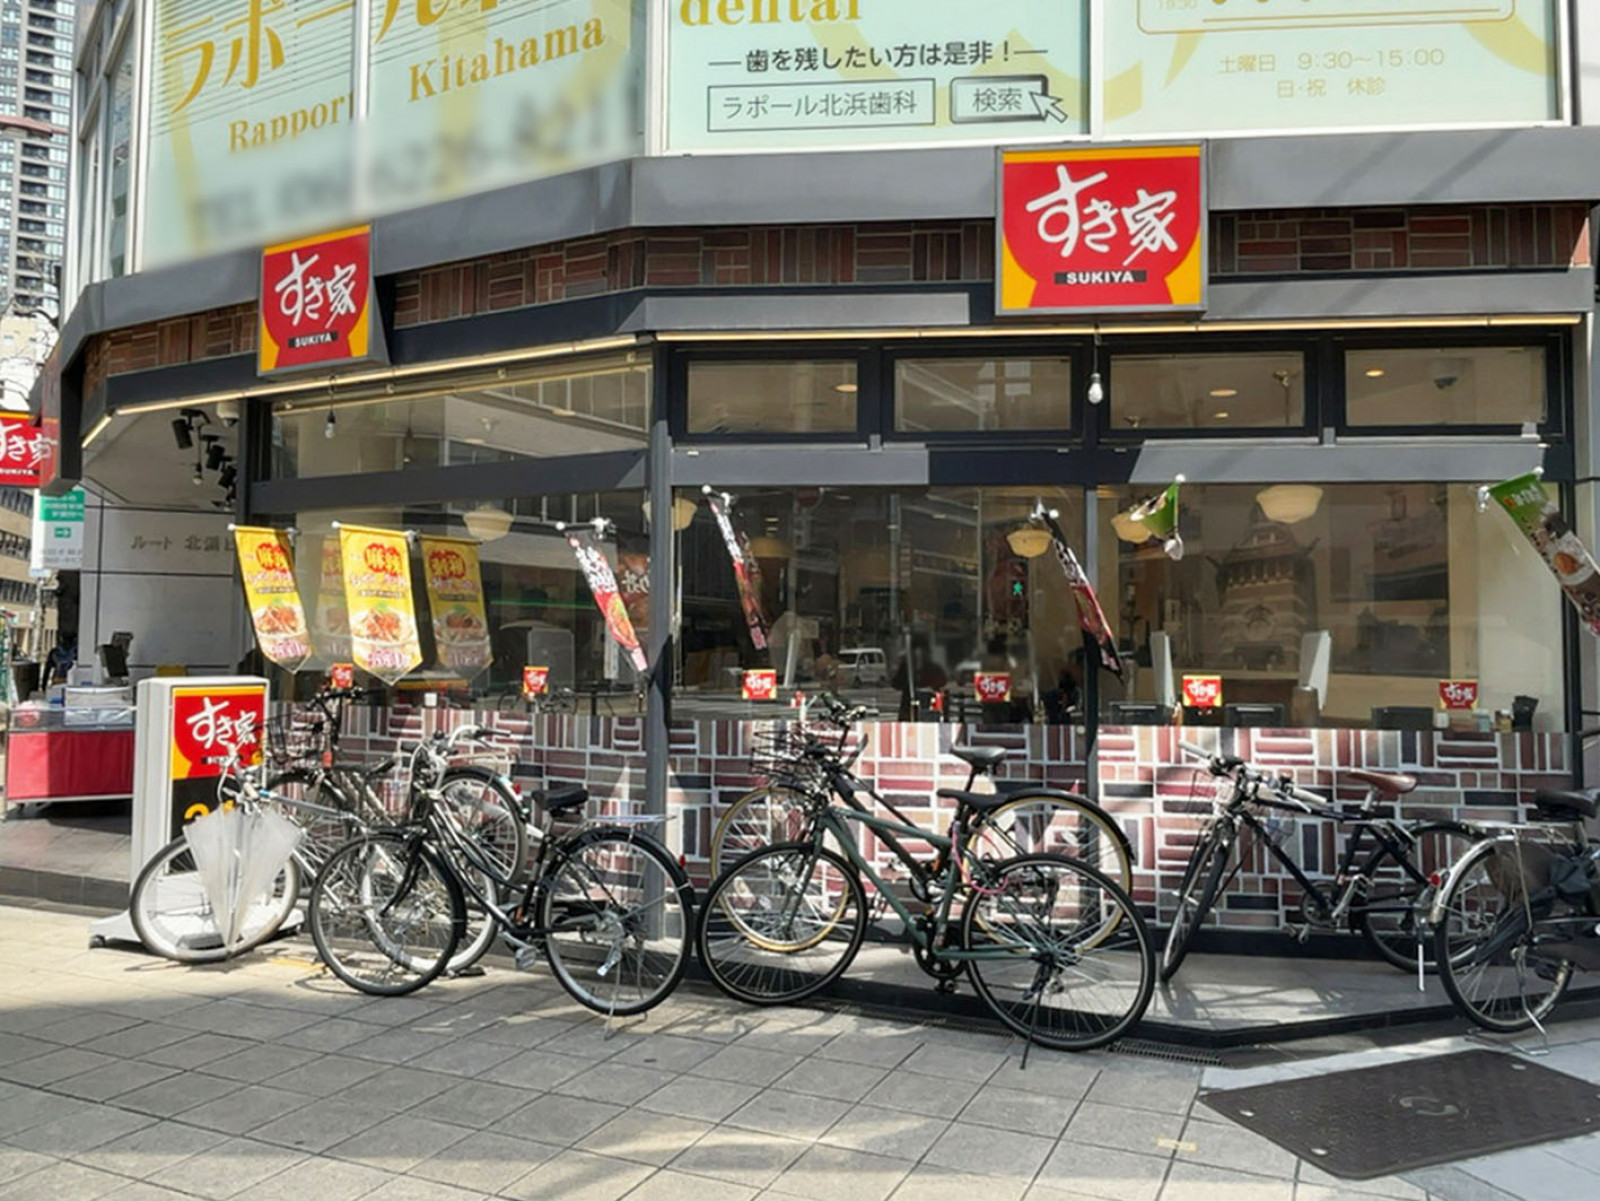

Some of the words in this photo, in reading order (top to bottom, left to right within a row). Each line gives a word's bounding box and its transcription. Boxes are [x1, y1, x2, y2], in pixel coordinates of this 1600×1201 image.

[408, 17, 605, 103] Kitahama
[1219, 54, 1277, 74] 土曜日
[972, 88, 1023, 112] 検索
[1347, 77, 1387, 96] 休診
[722, 90, 918, 119] ラポール北浜歯科
[1025, 164, 1179, 267] すき家
[274, 251, 357, 329] すき家
[1066, 271, 1134, 285] SUKIYA
[186, 697, 256, 750] すき家
